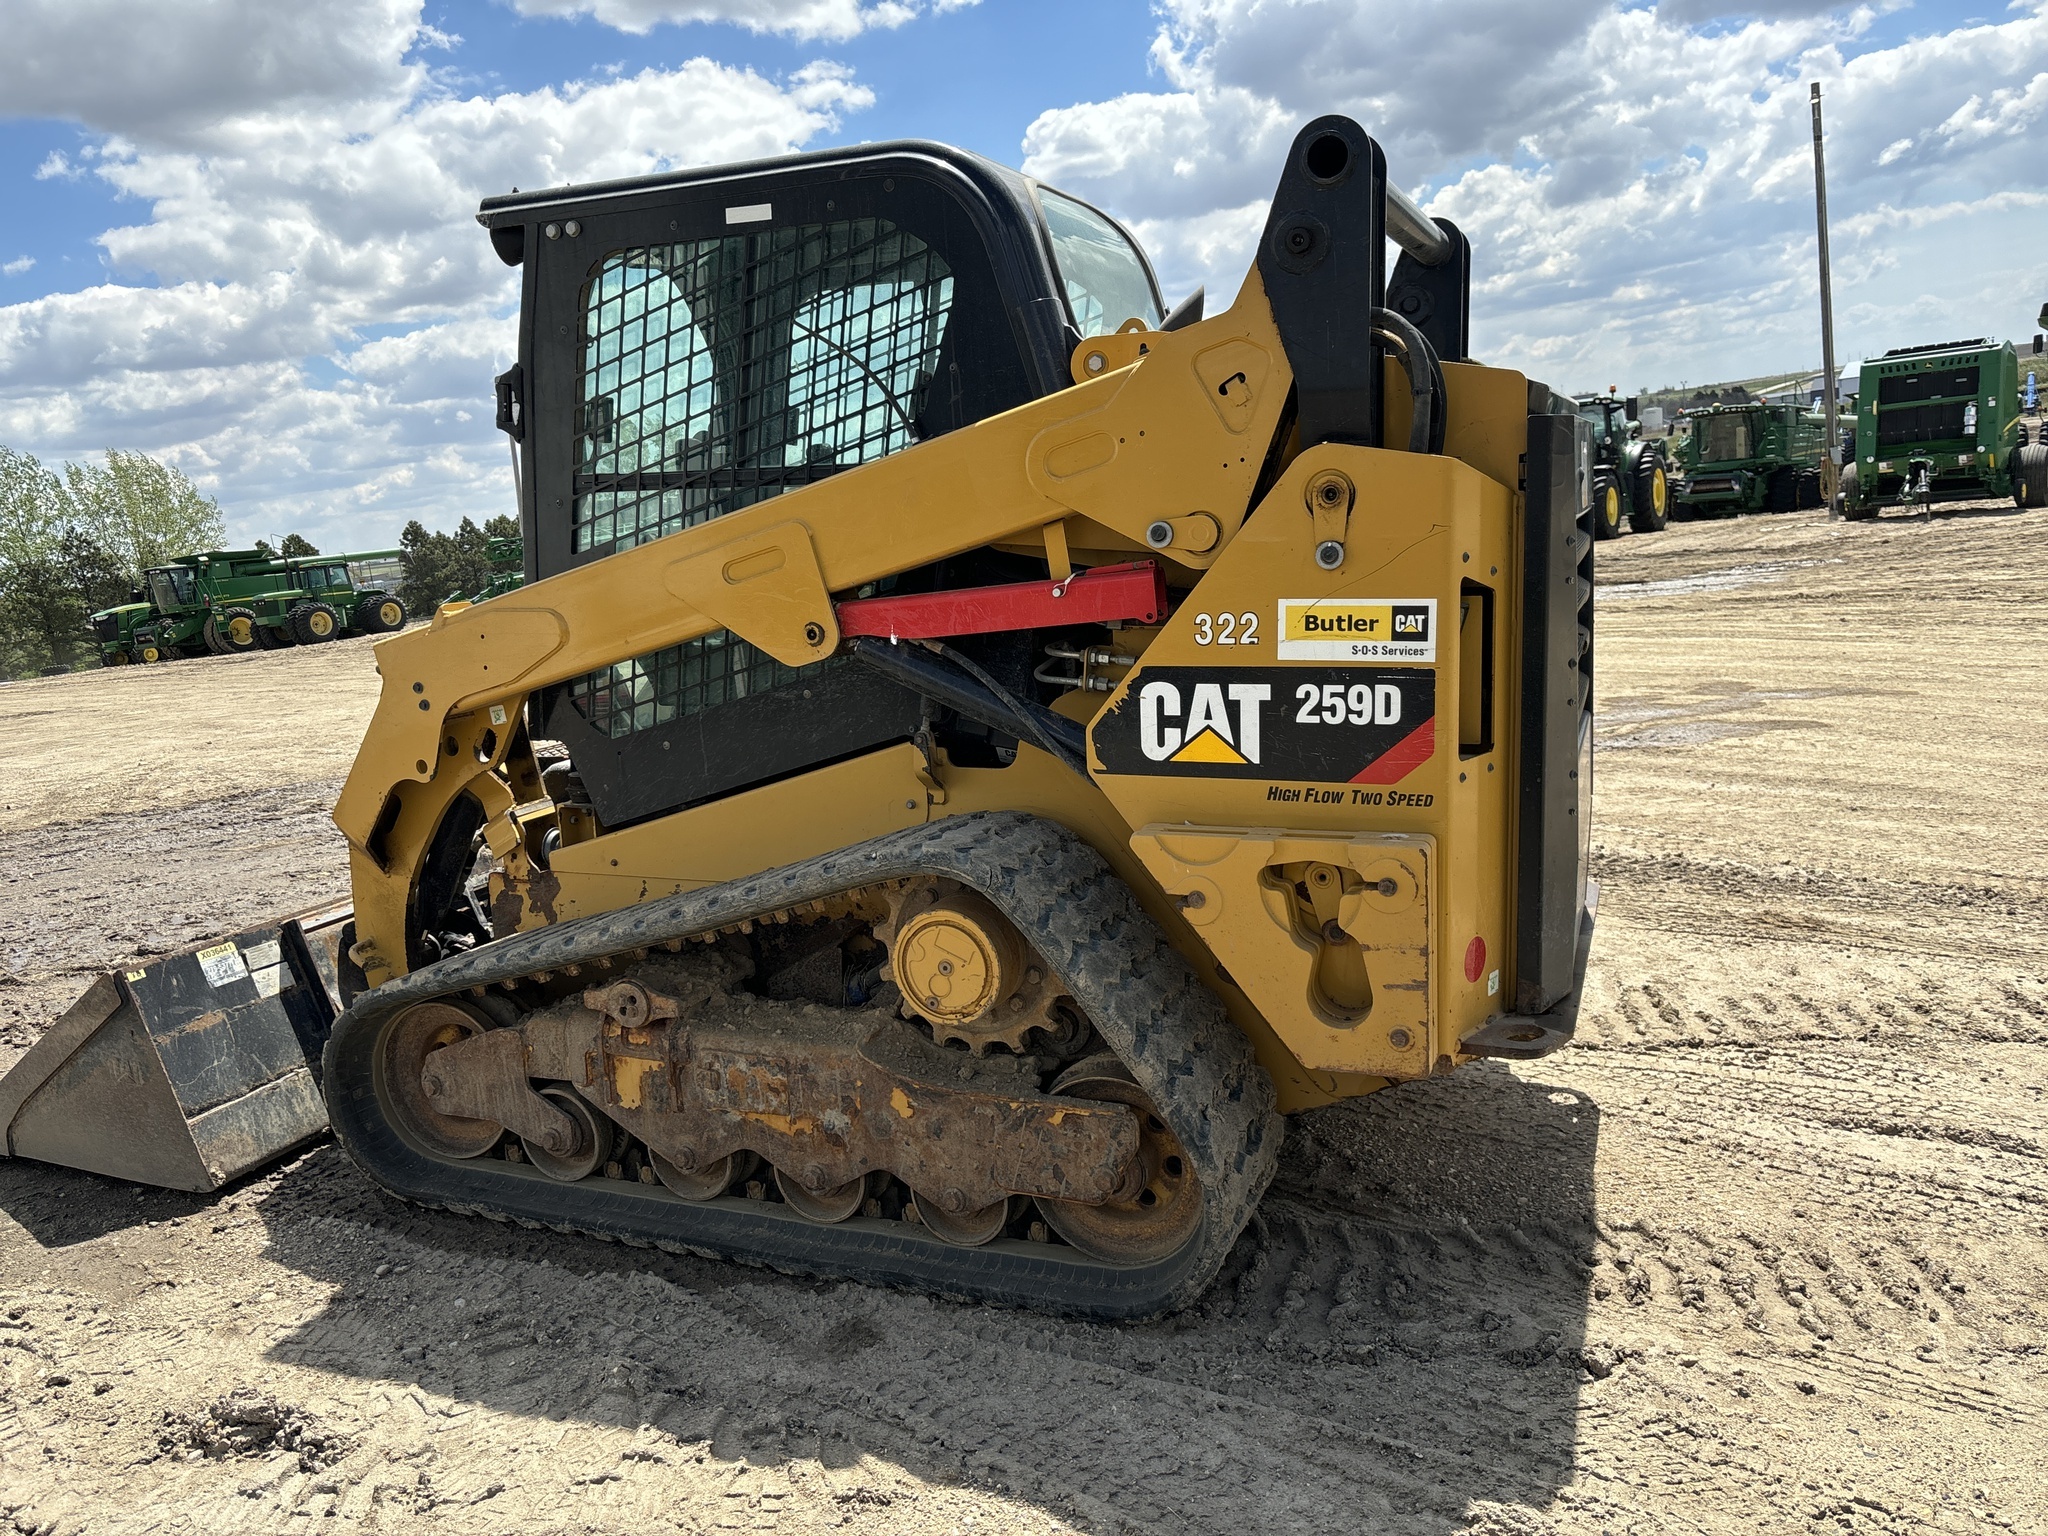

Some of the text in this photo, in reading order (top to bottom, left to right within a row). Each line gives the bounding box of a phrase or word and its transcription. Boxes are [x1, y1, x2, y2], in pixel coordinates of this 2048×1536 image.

[1194, 611, 1259, 646] 322
[1304, 614, 1425, 633] Butler CAT
[1381, 645, 1425, 656] Services
[1139, 681, 1402, 765] CAT 259D
[1267, 786, 1434, 807] HIGH FLOW TWO SPEED
[200, 944, 232, 960] X036441
